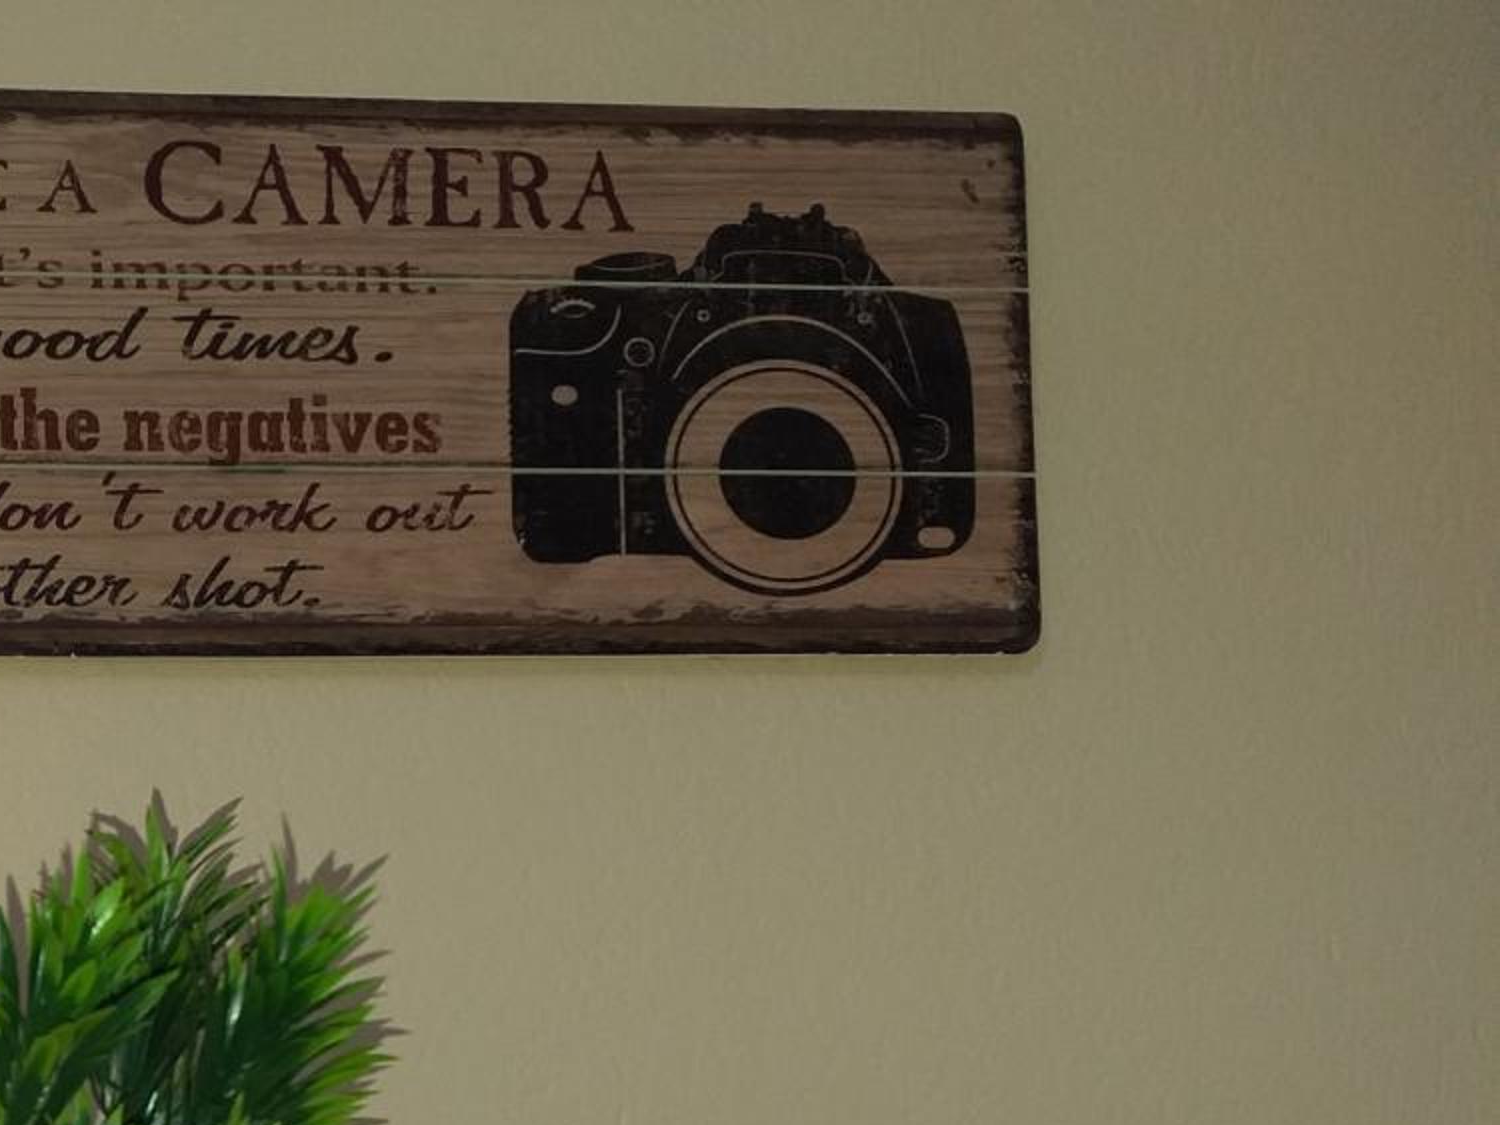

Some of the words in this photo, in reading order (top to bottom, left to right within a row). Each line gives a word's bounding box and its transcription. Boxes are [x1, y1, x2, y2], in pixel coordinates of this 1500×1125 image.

[37, 158, 98, 213] A
[143, 140, 635, 232] CAMERA
[90, 249, 439, 302] important.
[171, 308, 393, 365] times.
[0, 387, 100, 453] the
[123, 394, 444, 465] negatives
[172, 482, 338, 533] work
[365, 483, 496, 533] out
[162, 554, 325, 609] shot.
